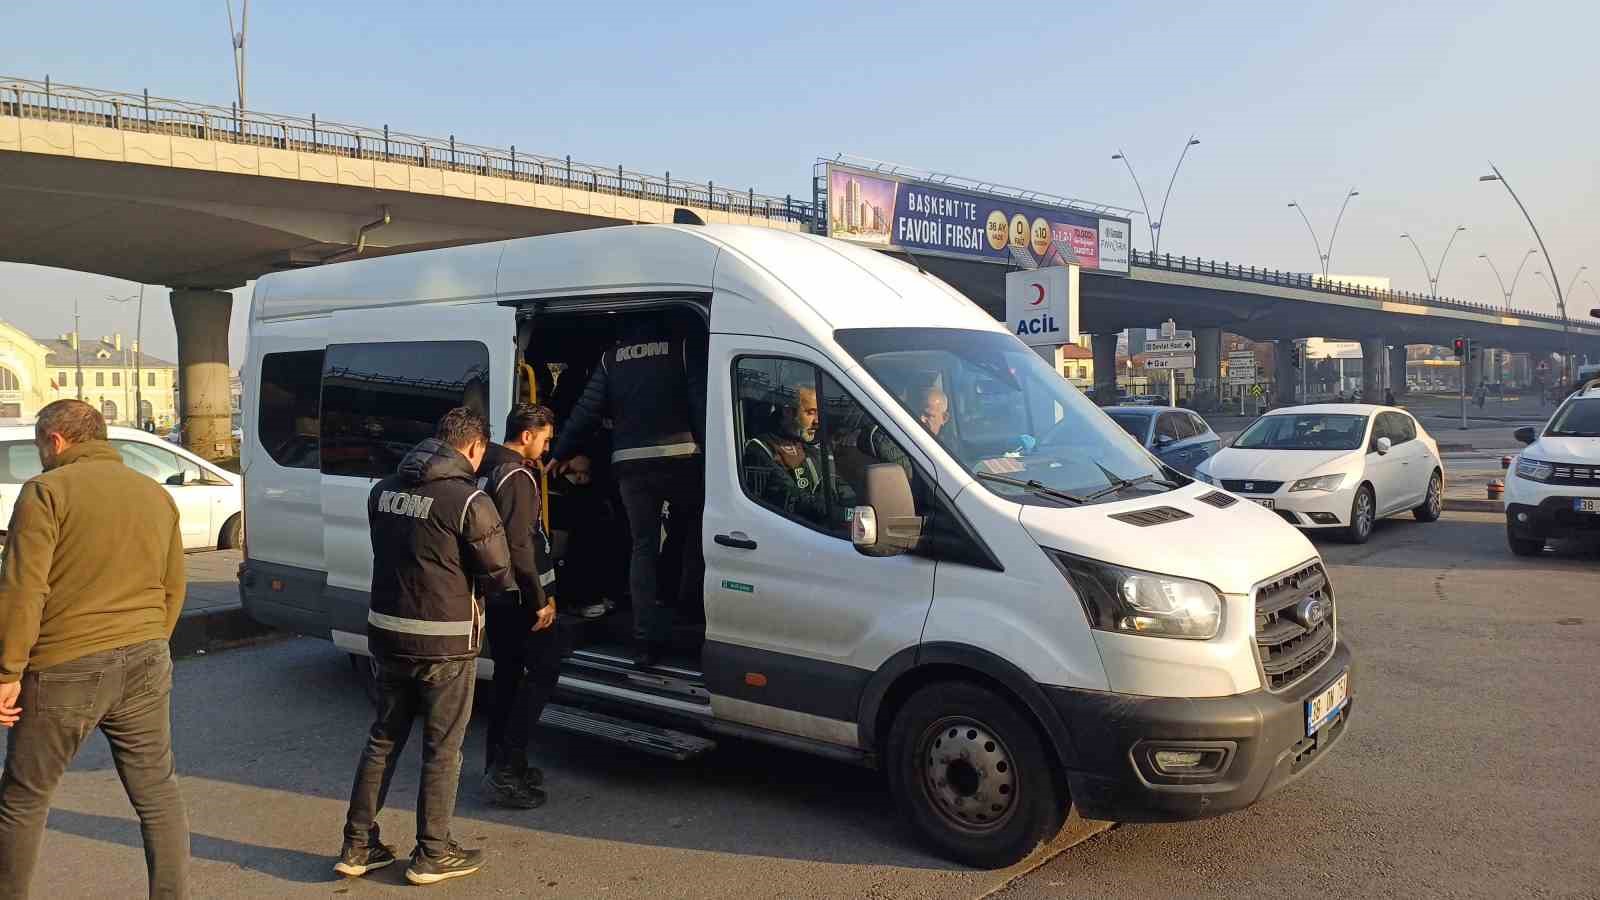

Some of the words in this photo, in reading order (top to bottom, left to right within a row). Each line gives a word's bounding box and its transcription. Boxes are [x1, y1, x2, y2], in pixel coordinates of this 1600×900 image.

[908, 192, 977, 221] BAŞKENT'TE
[899, 216, 942, 245] FAVORİ
[945, 223, 985, 251] FIRSAT
[1016, 220, 1023, 234] 0
[1016, 313, 1060, 336] ACİL
[615, 341, 669, 362] KOM
[1154, 359, 1169, 368] Gar
[377, 489, 435, 520] KOM
[1583, 500, 1594, 511] 38
